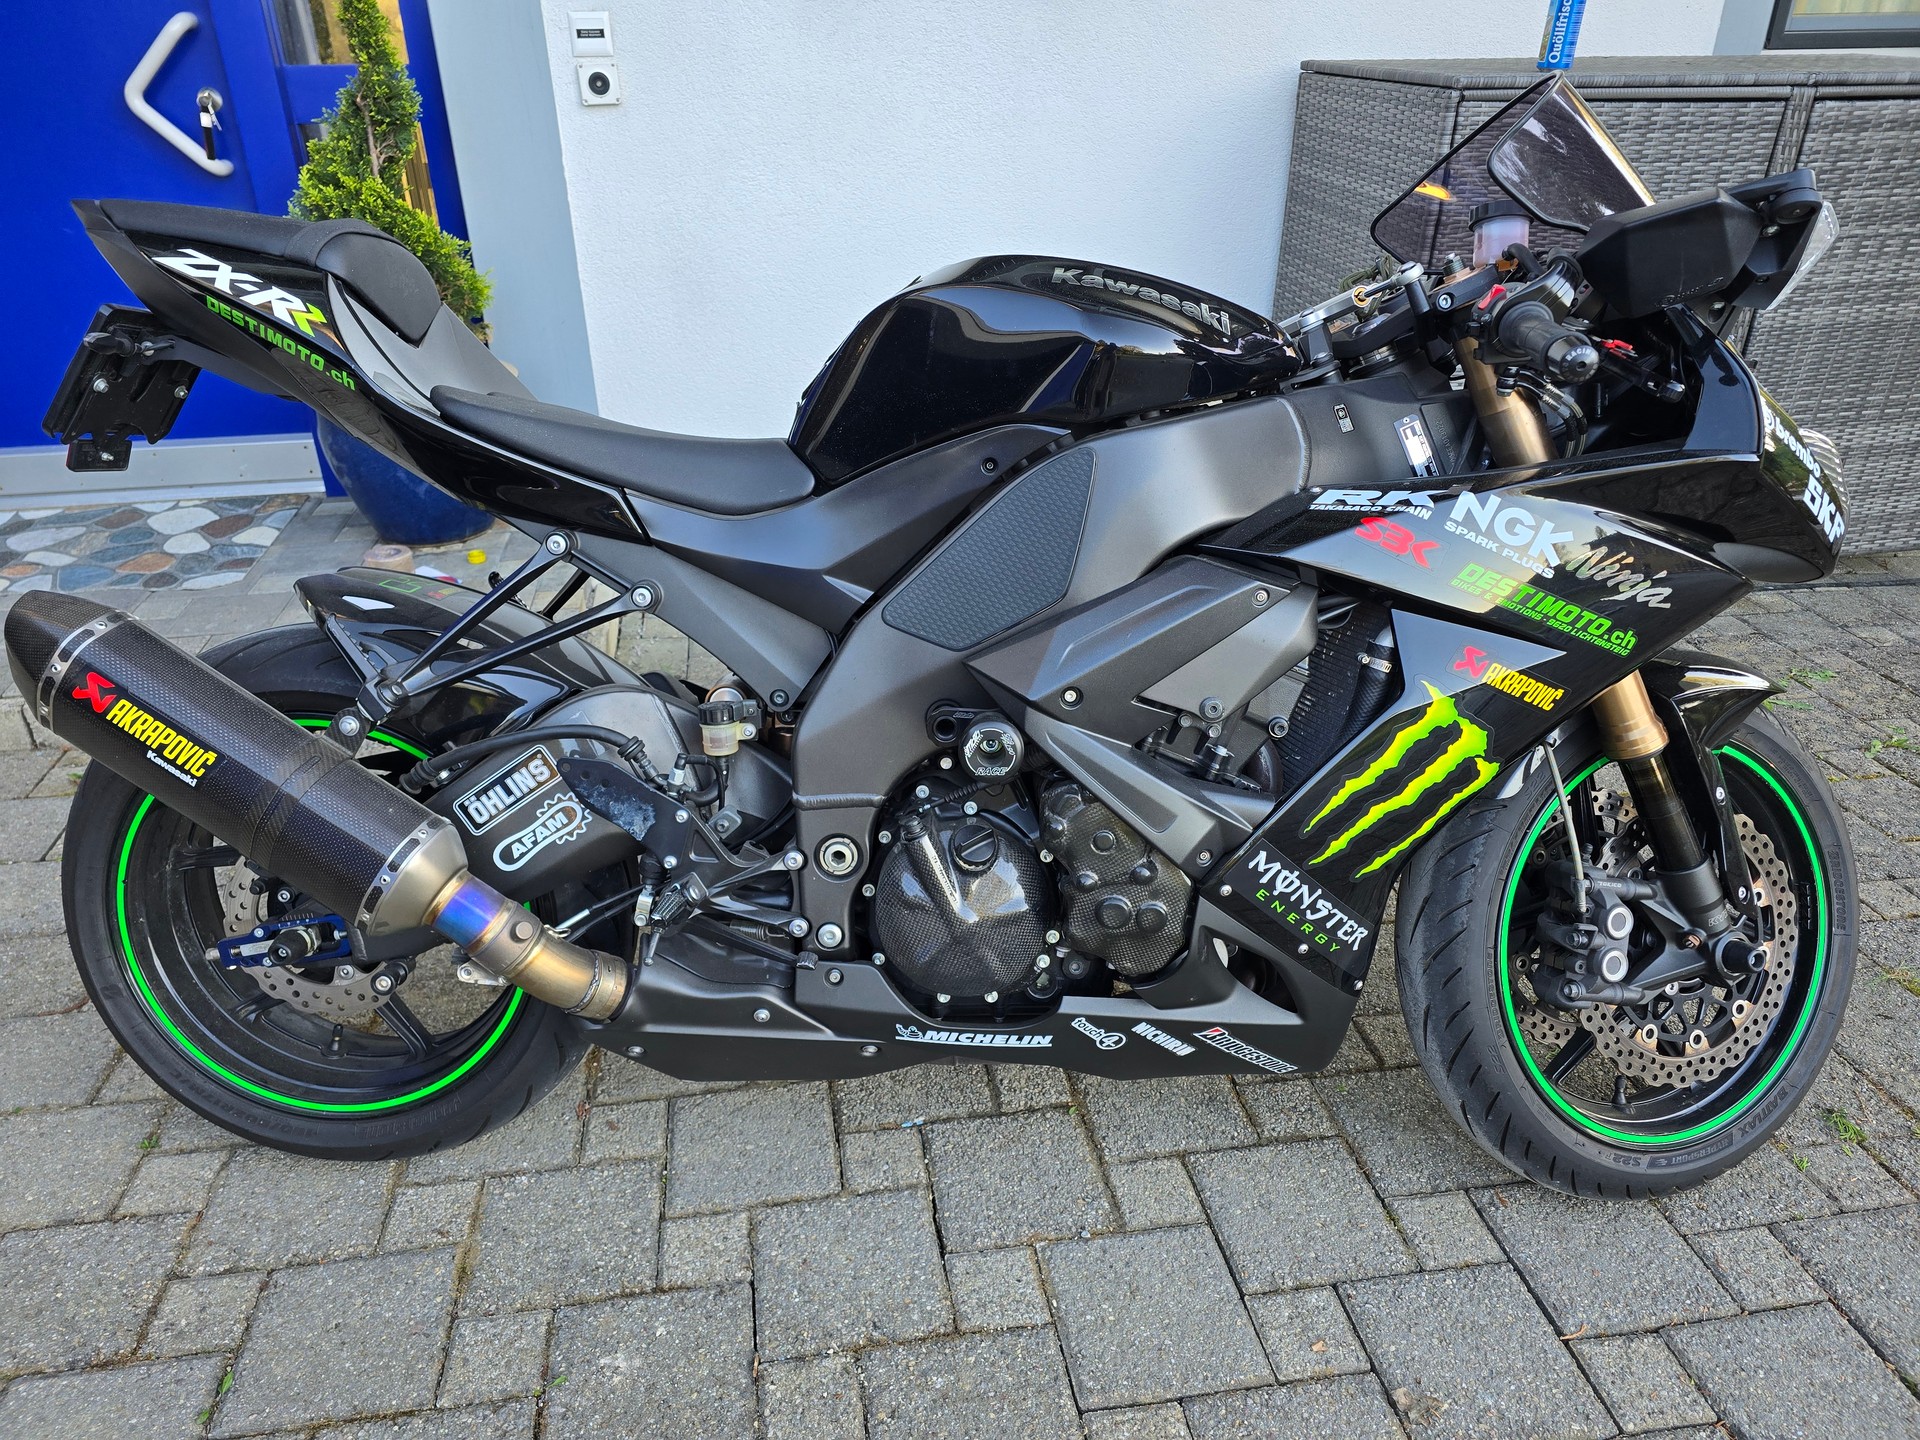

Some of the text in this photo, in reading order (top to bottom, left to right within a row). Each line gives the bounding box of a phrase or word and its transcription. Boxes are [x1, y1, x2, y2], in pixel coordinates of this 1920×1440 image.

[1051, 267, 1231, 336] Kawasaki
[206, 295, 356, 391] DESTIMOTO.ch
[1775, 416, 1821, 478] brembo
[1312, 489, 1449, 508] RK
[1385, 505, 1434, 520] CHAIN
[1354, 517, 1440, 571] SBK
[1444, 520, 1555, 579] SPARK PLUGS
[1450, 490, 1574, 567] NGK
[1457, 563, 1637, 650] DESTIMOTO.ch
[1565, 546, 1673, 609] Ninja
[1450, 578, 1482, 595] BIKES
[1495, 597, 1543, 621] EMOTIONS
[1547, 619, 1572, 633] 9620
[1570, 628, 1631, 656] LICHTENSTEIG
[146, 750, 198, 787] Kawasaki
[463, 757, 551, 824] ÖHLINS
[511, 811, 569, 859] AFAM
[1827, 850, 1847, 931] BRIDGESTONE
[1255, 889, 1340, 952] ENERGY
[924, 1030, 1053, 1045] MICHELIN
[1131, 1021, 1196, 1057] NICHIRIN
[1195, 1027, 1298, 1073] BRIDGESTONE
[1737, 1086, 1789, 1138] BATTLAX
[1671, 1138, 1730, 1165] HYPERSPORT
